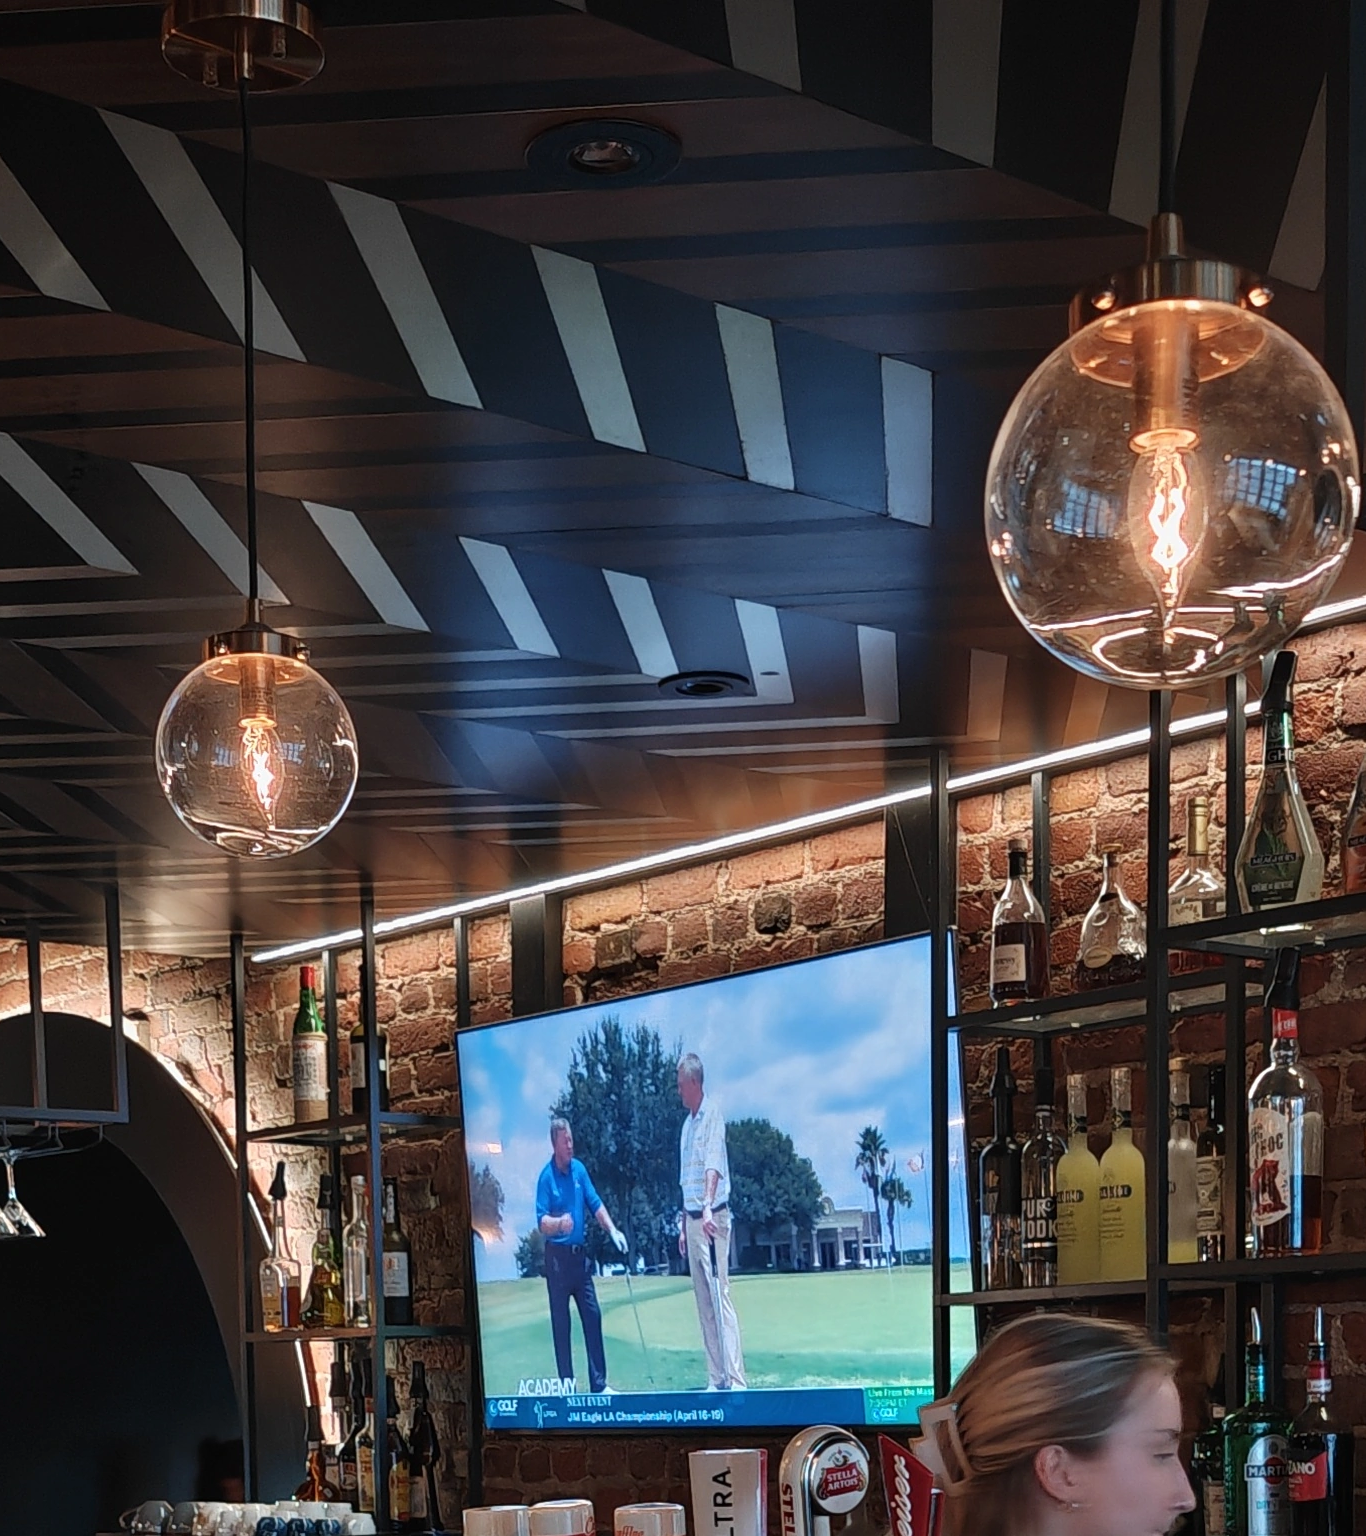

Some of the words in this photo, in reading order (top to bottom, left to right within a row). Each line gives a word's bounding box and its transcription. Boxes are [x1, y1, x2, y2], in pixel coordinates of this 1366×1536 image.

[517, 1378, 577, 1398] ACADEMY
[497, 1400, 519, 1412] GOLF
[827, 1468, 858, 1482] STELLA
[1248, 1465, 1286, 1478] MARTI
[828, 1479, 858, 1491] ARTOIS
